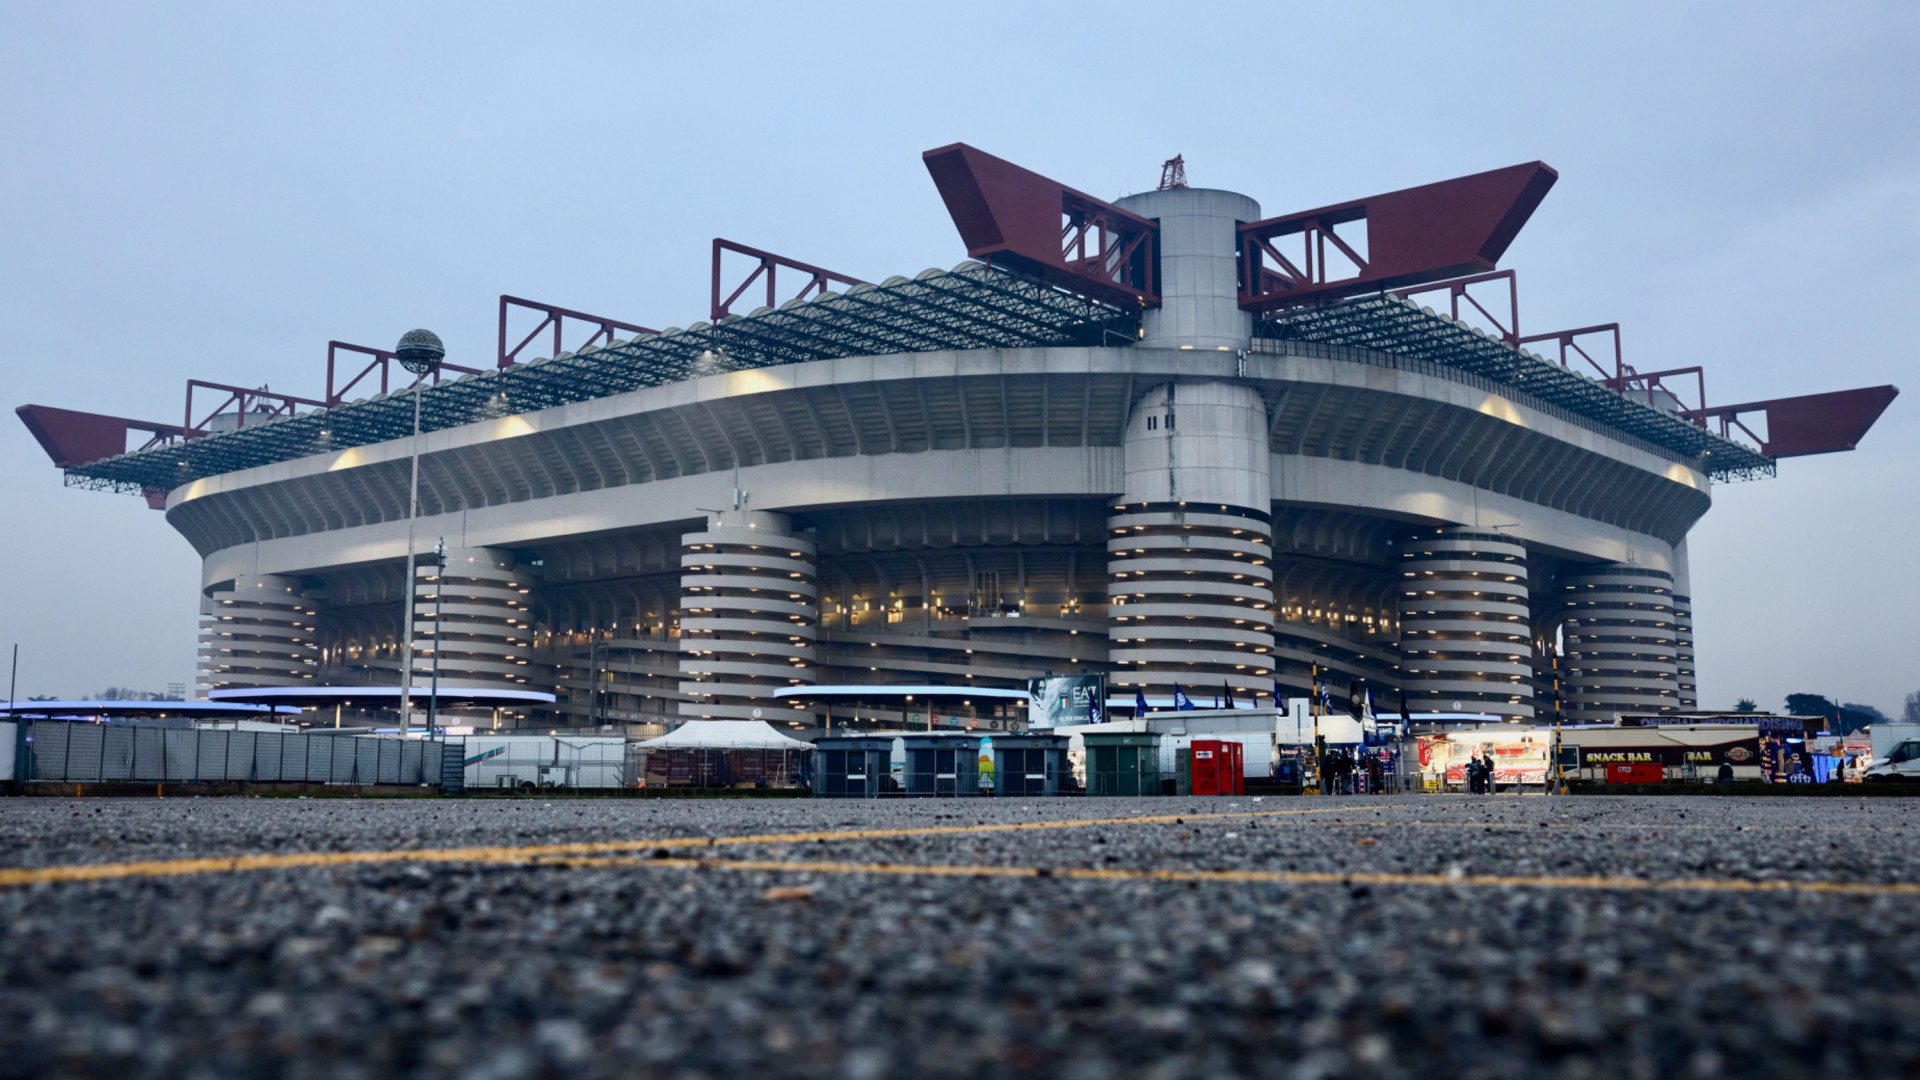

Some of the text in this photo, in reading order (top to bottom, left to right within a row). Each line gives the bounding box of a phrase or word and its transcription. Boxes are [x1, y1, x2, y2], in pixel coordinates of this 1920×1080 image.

[1587, 753, 1652, 762] SNACK BAR
[1688, 752, 1712, 760] BAR
